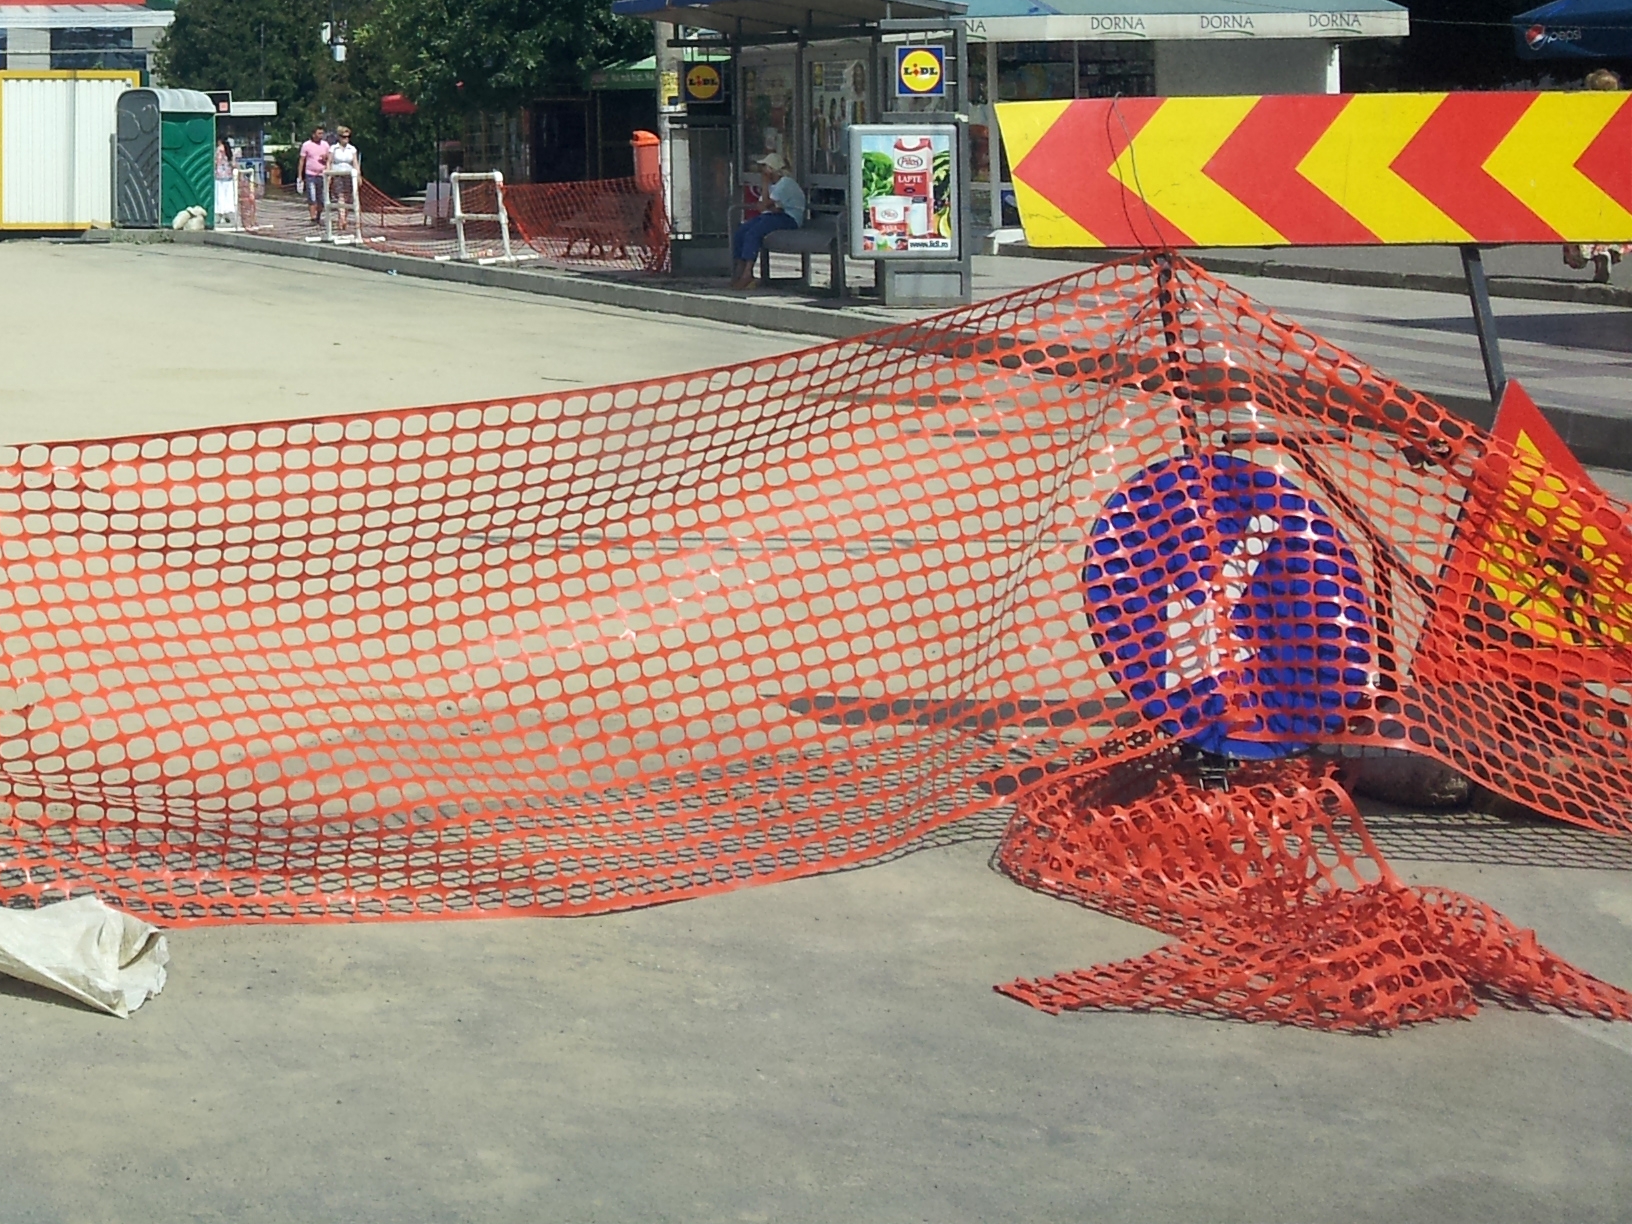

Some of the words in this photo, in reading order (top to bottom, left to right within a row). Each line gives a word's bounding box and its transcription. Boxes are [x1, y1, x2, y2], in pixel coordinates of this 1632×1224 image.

[1090, 16, 1145, 30] DORNA
[1200, 15, 1254, 29] DORNA
[1309, 13, 1361, 27] DORNA
